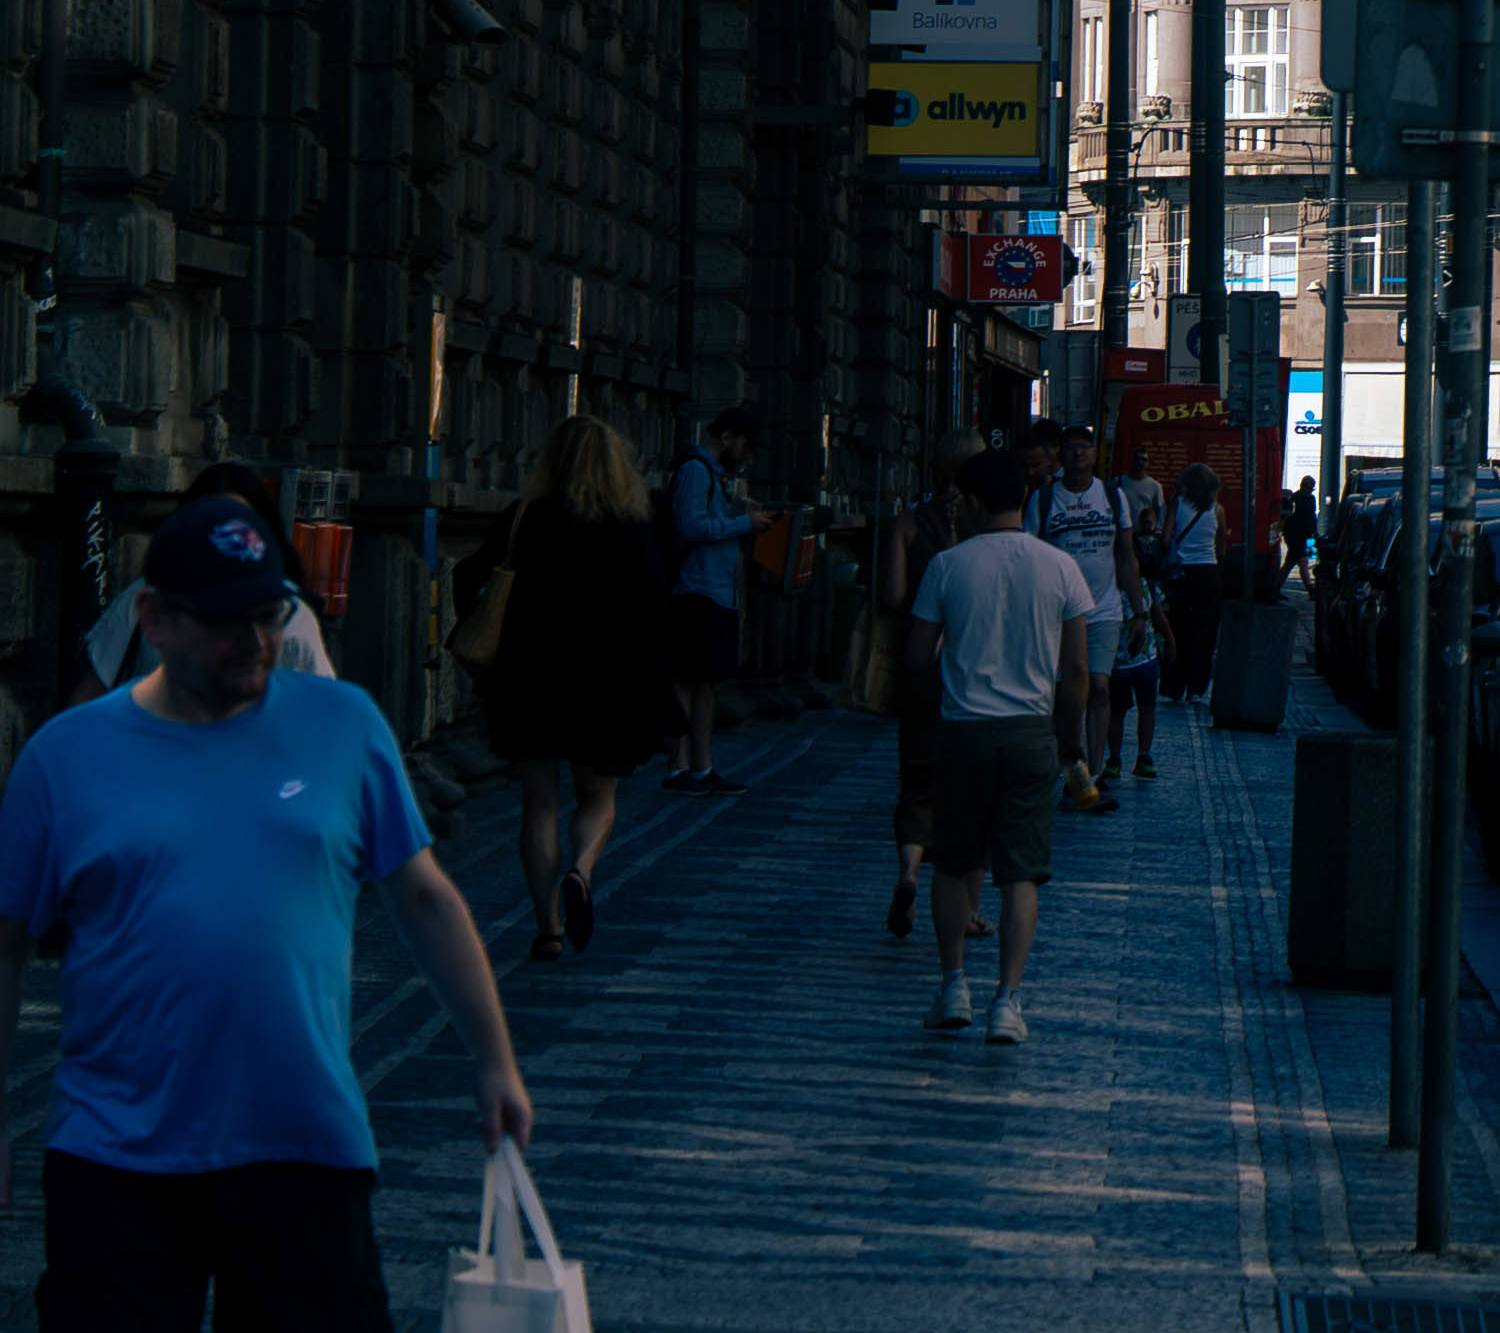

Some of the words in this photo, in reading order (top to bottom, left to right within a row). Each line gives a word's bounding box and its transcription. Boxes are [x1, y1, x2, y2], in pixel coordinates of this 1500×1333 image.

[912, 11, 998, 29] Balíkovna
[927, 92, 1027, 129] allwyn
[983, 236, 1048, 269] EXCHANGE
[988, 288, 1039, 301] PRAHA
